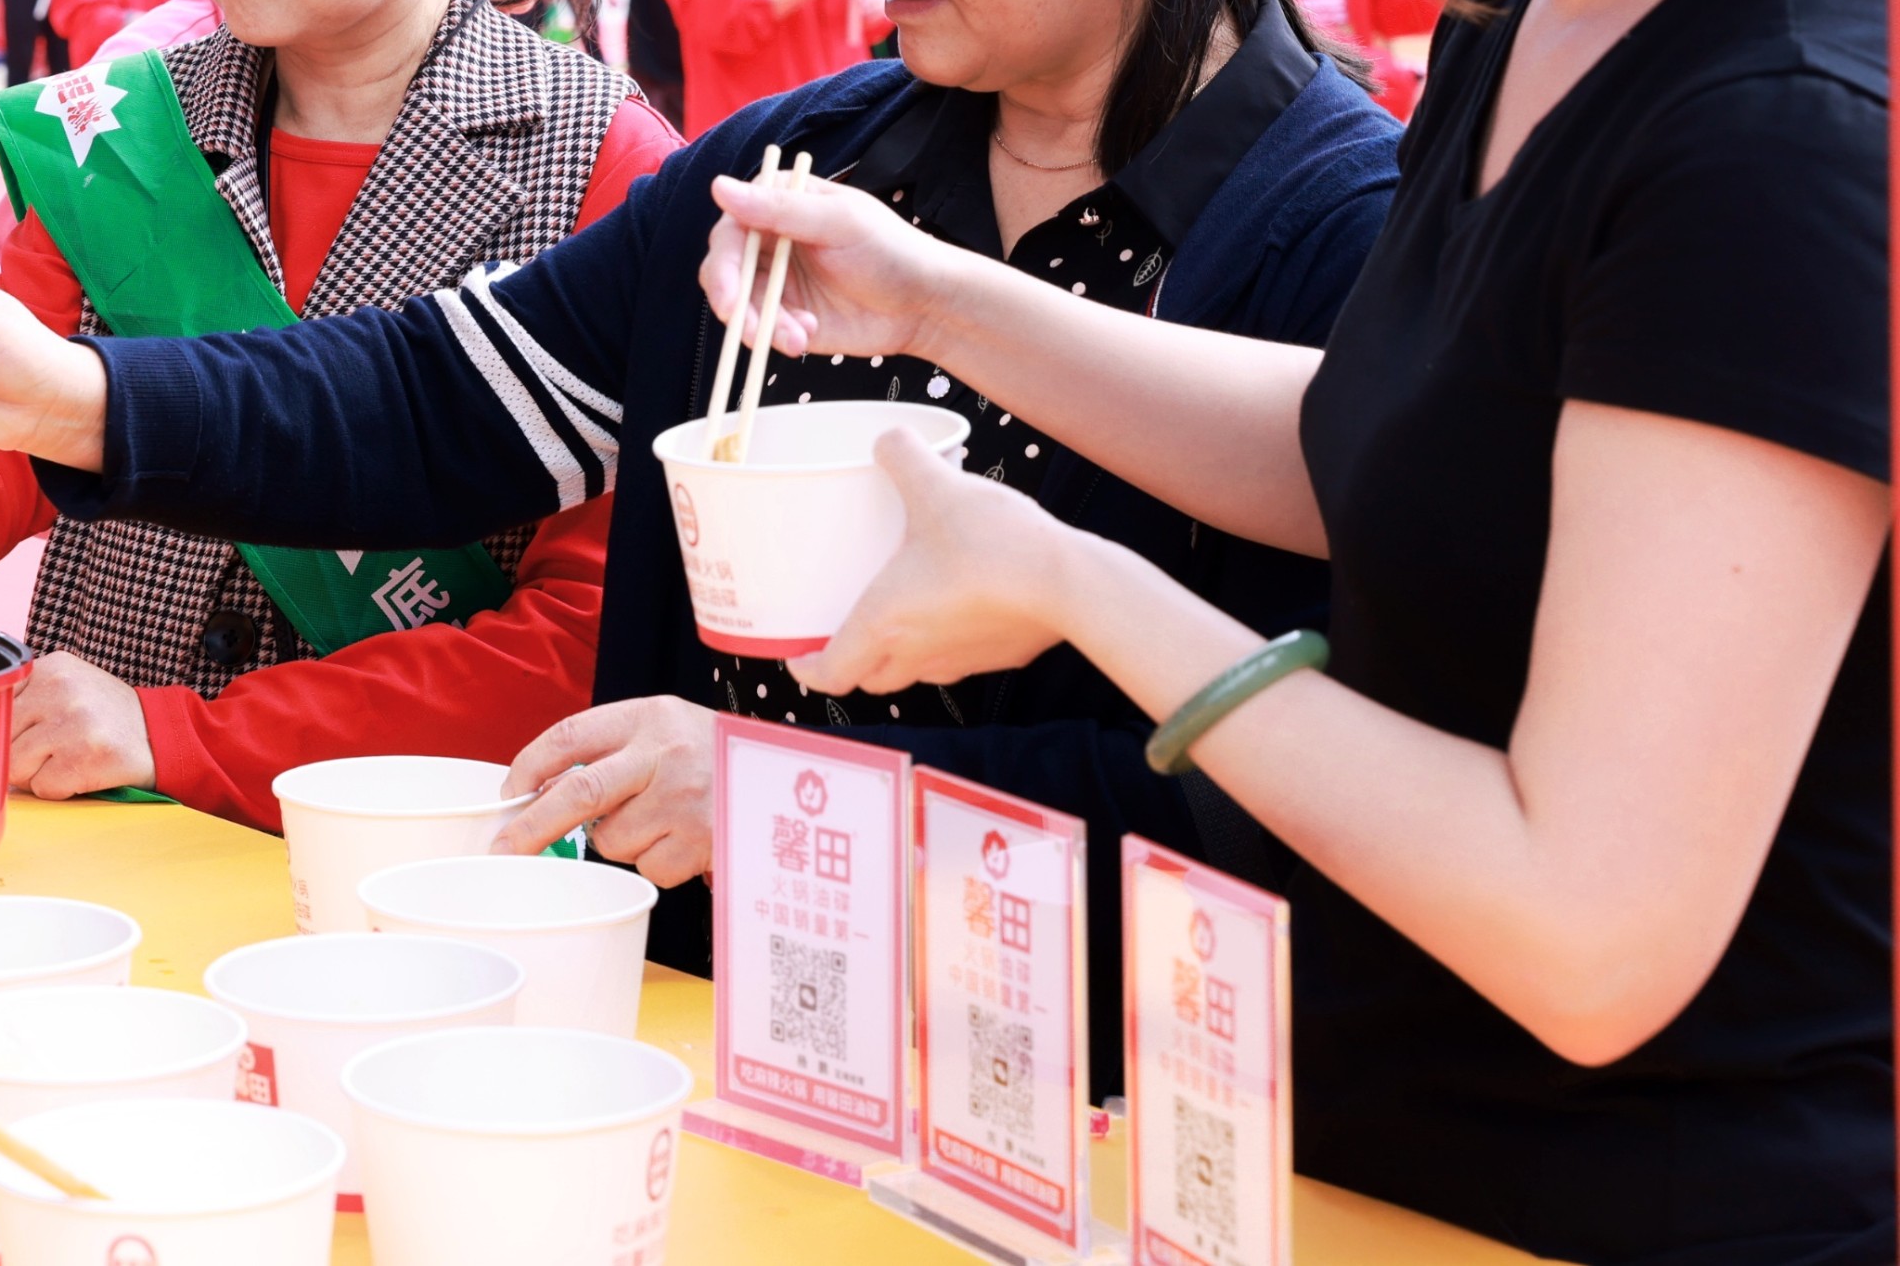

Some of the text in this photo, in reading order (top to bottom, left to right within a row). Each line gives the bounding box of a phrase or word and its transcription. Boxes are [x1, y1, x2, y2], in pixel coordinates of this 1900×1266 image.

[771, 813, 851, 884] 馨田
[755, 898, 870, 942] 中国销量第一
[771, 875, 850, 914] 火锅油碟
[962, 875, 1031, 954] 馨田
